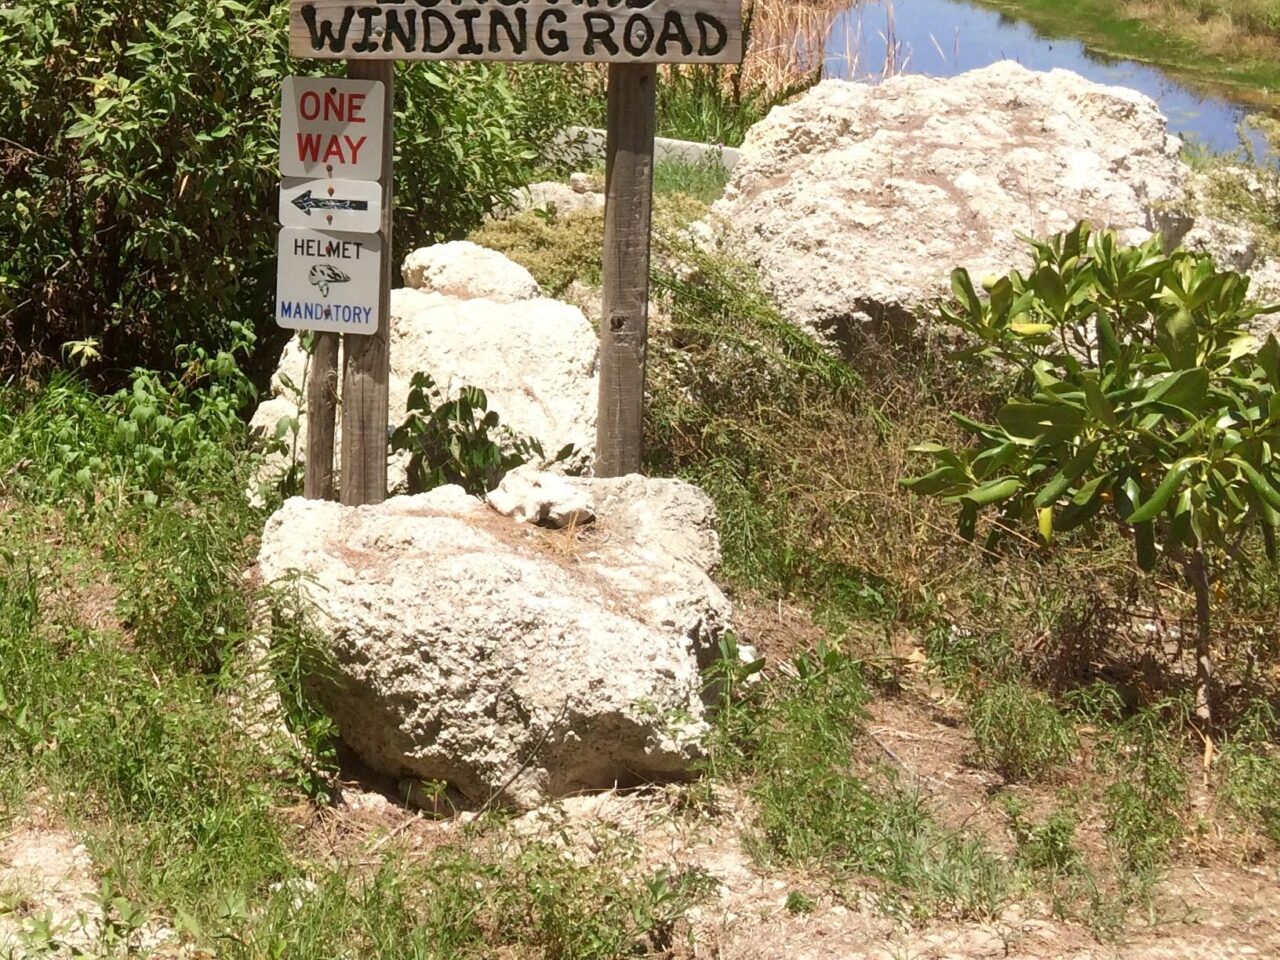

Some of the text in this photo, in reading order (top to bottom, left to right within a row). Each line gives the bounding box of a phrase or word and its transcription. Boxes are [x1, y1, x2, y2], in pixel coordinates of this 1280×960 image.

[300, 4, 728, 56] WINDING ROAD
[299, 91, 366, 123] ONE
[296, 133, 367, 164] WAY
[294, 238, 363, 260] HELMET
[281, 301, 372, 324] MANDATORY
